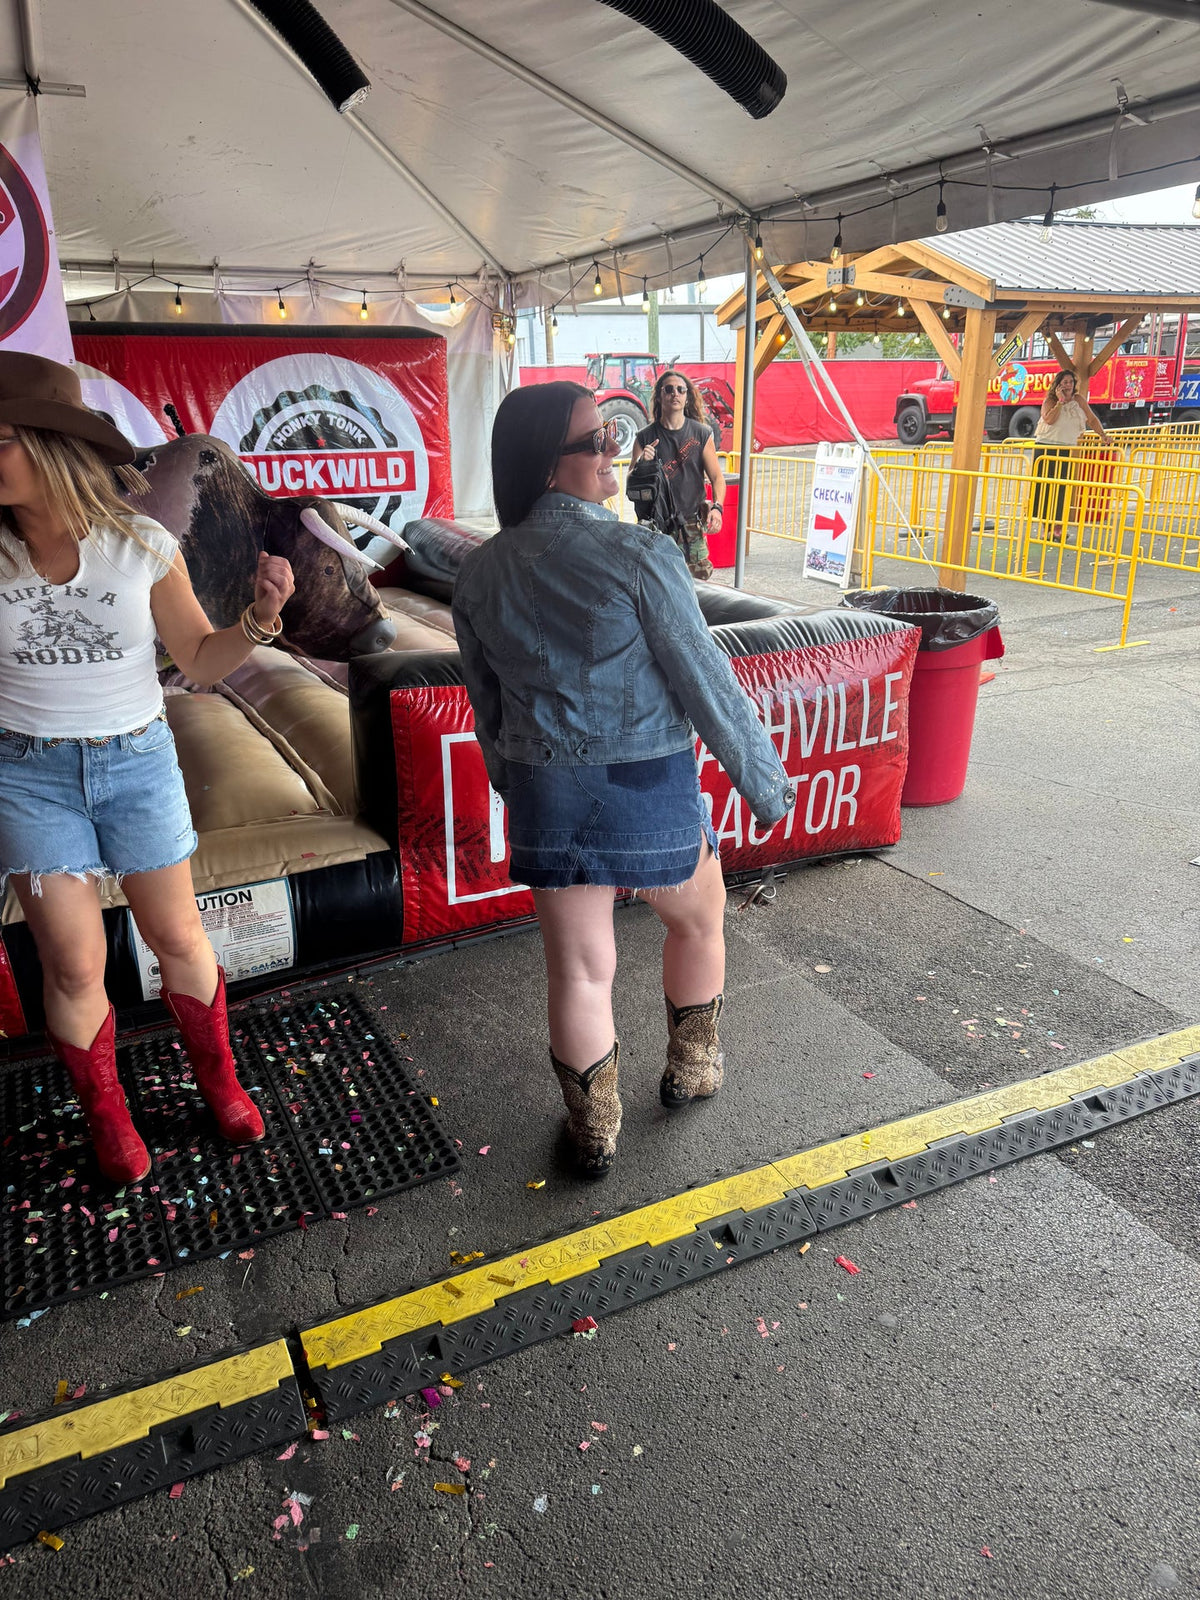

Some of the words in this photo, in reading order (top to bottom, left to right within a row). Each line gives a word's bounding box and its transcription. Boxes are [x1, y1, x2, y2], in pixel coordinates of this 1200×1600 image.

[986, 375, 1002, 393] IG
[272, 413, 321, 447] HONKY
[325, 413, 368, 445] TONK
[813, 487, 853, 504] CHECK-IN
[0, 584, 54, 605] LIFE
[64, 585, 89, 599] IS
[97, 591, 118, 607] A
[9, 647, 124, 665] RODEO
[698, 671, 903, 776] HVILLE
[195, 889, 253, 912] UTION
